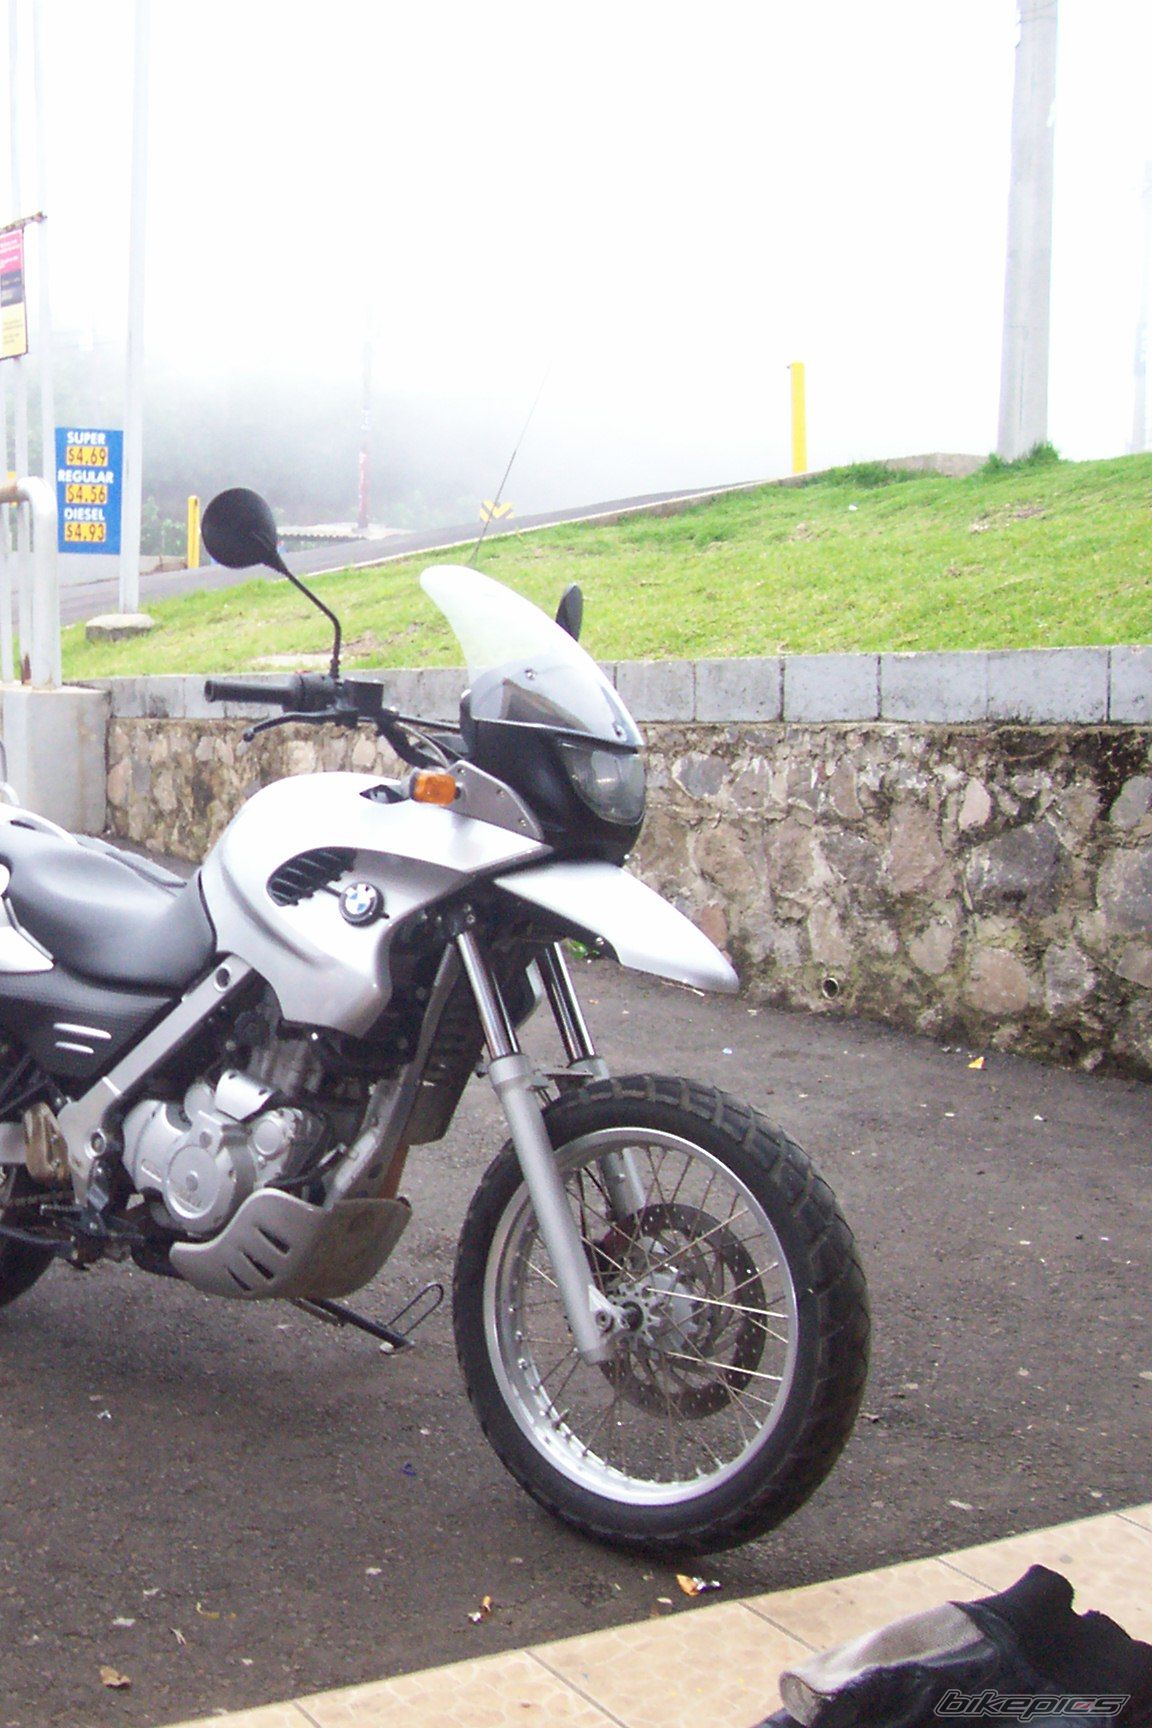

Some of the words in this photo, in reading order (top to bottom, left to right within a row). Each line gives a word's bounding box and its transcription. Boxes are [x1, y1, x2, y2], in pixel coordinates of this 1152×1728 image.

[67, 431, 106, 444] SUPER
[68, 447, 106, 465] $4.69
[57, 469, 114, 483] REGULAR
[67, 485, 106, 503] $4.56
[64, 507, 105, 520] DIESEL
[67, 523, 104, 541] $4.93
